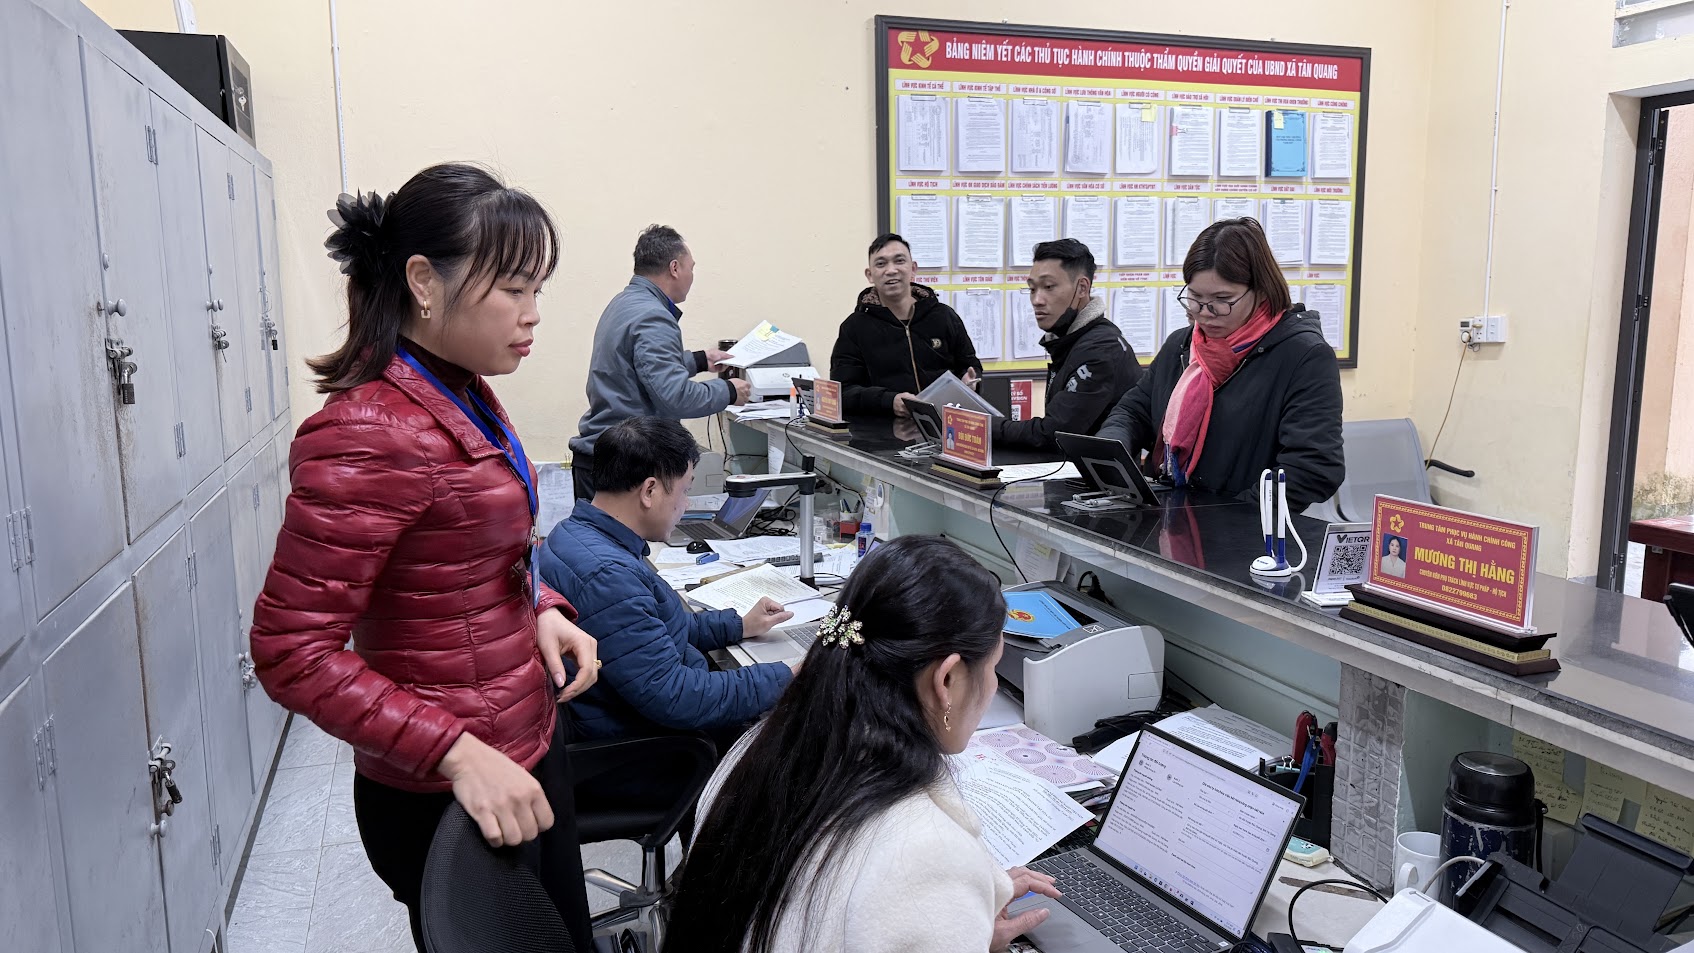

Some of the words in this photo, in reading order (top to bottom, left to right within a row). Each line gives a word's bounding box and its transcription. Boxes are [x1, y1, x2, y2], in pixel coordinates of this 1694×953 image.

[946, 37, 969, 59] BẢNG
[972, 40, 994, 61] NIÊM
[996, 40, 1012, 61] YẾT
[1014, 42, 1032, 63] CÁC
[1034, 43, 1051, 64] THỦ
[1053, 48, 1069, 68] TỤC
[1072, 46, 1094, 66] HÀNH
[1096, 47, 1122, 67] CHÍNH
[1124, 49, 1151, 71] THUỘC
[1153, 47, 1176, 70] THẨM
[1177, 50, 1203, 72] QUYỀN
[1204, 53, 1220, 72] GIẢI
[1222, 53, 1247, 74] QUYẾT
[1248, 54, 1263, 75] CỦA
[1265, 61, 1285, 76] UBND
[1286, 59, 1296, 77] XÃ
[1298, 60, 1312, 78] TÂN
[1313, 63, 1338, 79] QUANG
[1414, 547, 1455, 569] MƯƠNG
[1459, 558, 1477, 578] THỊ
[1480, 559, 1515, 584] HẰNG
